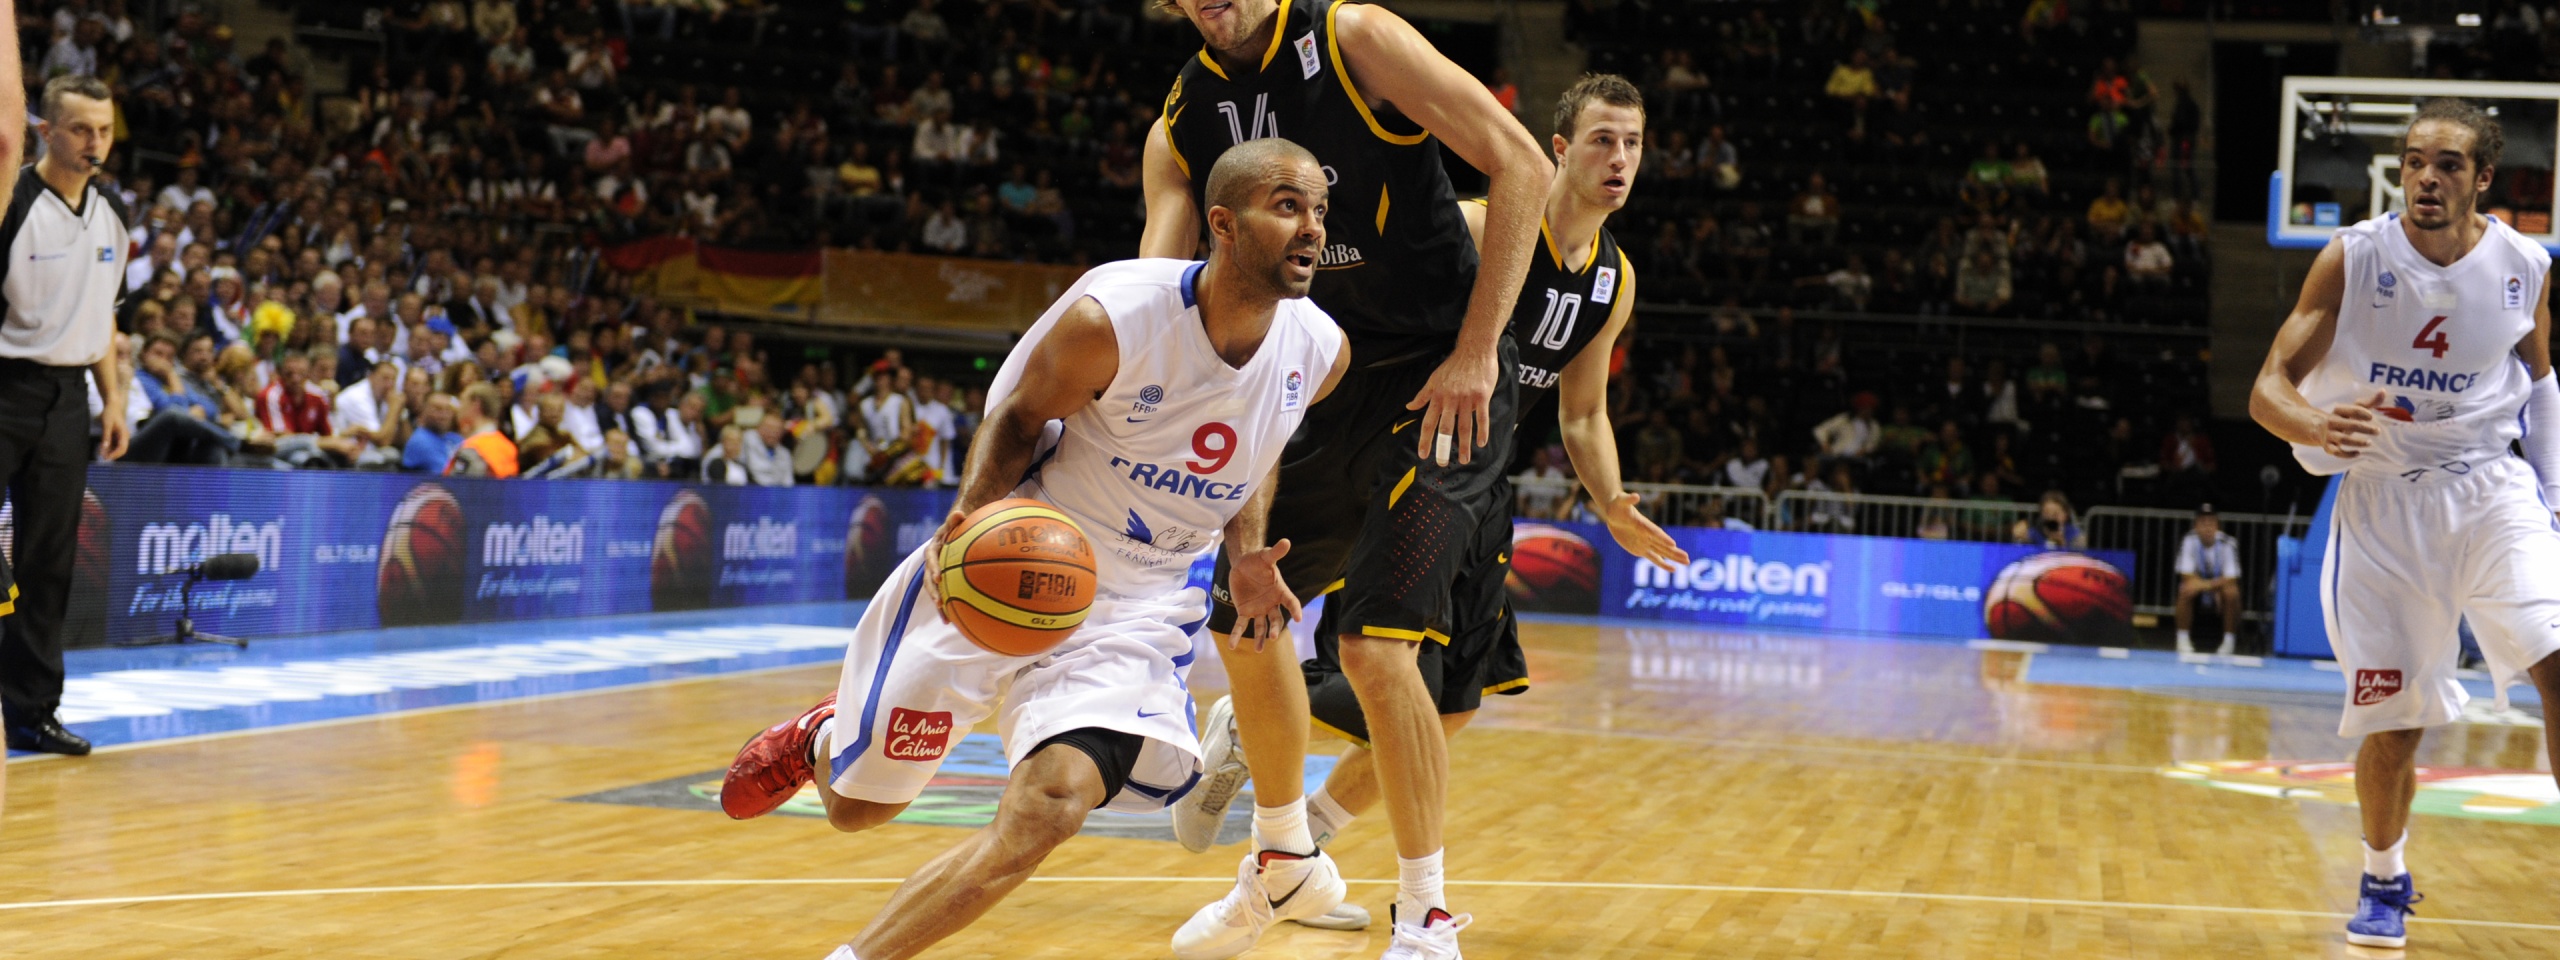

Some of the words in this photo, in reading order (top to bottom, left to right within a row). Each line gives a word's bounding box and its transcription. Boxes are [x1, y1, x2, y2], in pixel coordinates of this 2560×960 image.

[1217, 92, 1279, 146] 14
[1530, 287, 1582, 350] 10
[2412, 315, 2449, 359] 4
[2369, 362, 2480, 393] FRANCE
[1186, 422, 1238, 475] 9
[138, 514, 280, 574] molten
[483, 515, 584, 566] molten
[998, 523, 1090, 556] molten
[1019, 545, 1079, 560] OFFICIAL
[1035, 572, 1077, 597] FIBA
[1633, 554, 1829, 597] molten
[1626, 588, 1667, 609] For
[1667, 590, 1706, 611] the
[1708, 593, 1764, 613] real
[1031, 617, 1057, 626] GL7
[910, 717, 948, 736] Mie
[889, 734, 943, 758] Câline
